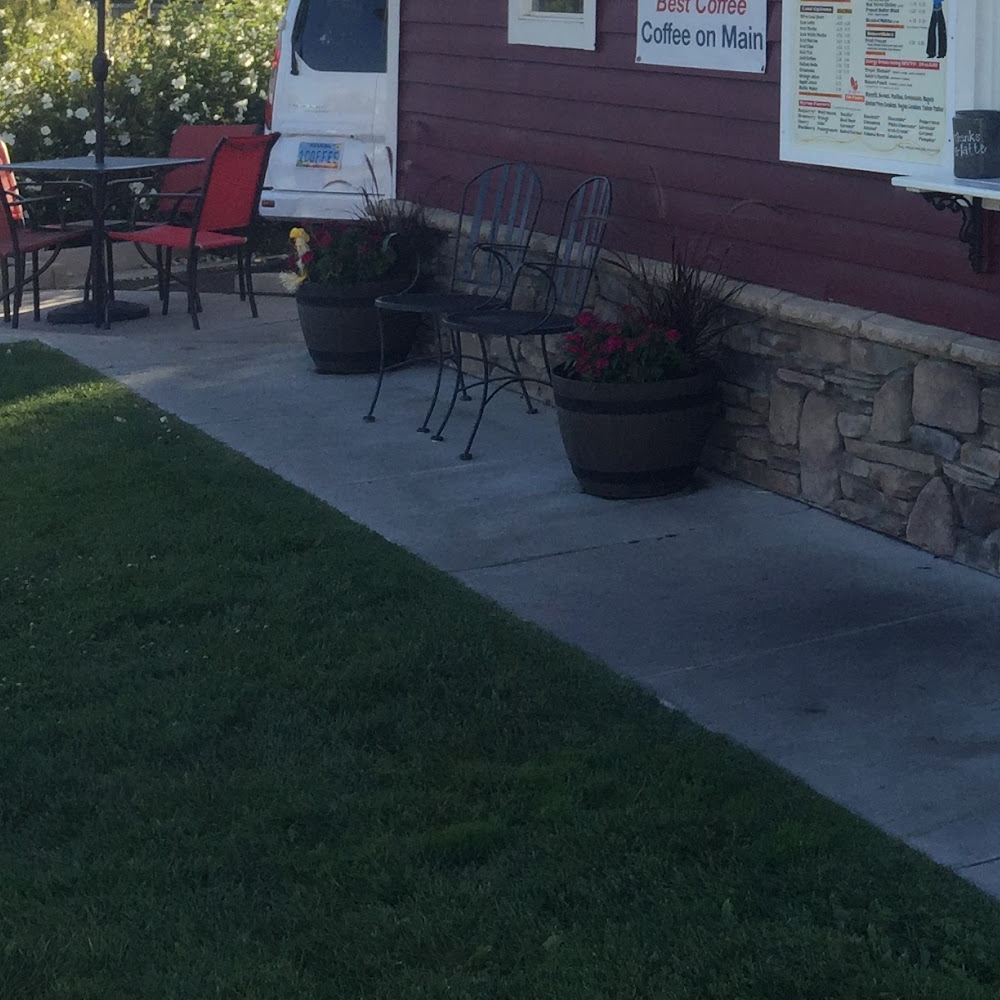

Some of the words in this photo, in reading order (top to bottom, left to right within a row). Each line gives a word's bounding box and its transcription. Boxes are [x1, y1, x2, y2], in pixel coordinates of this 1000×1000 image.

[641, 20, 691, 46] Coffee
[696, 28, 716, 47] on
[721, 24, 763, 50] Main
